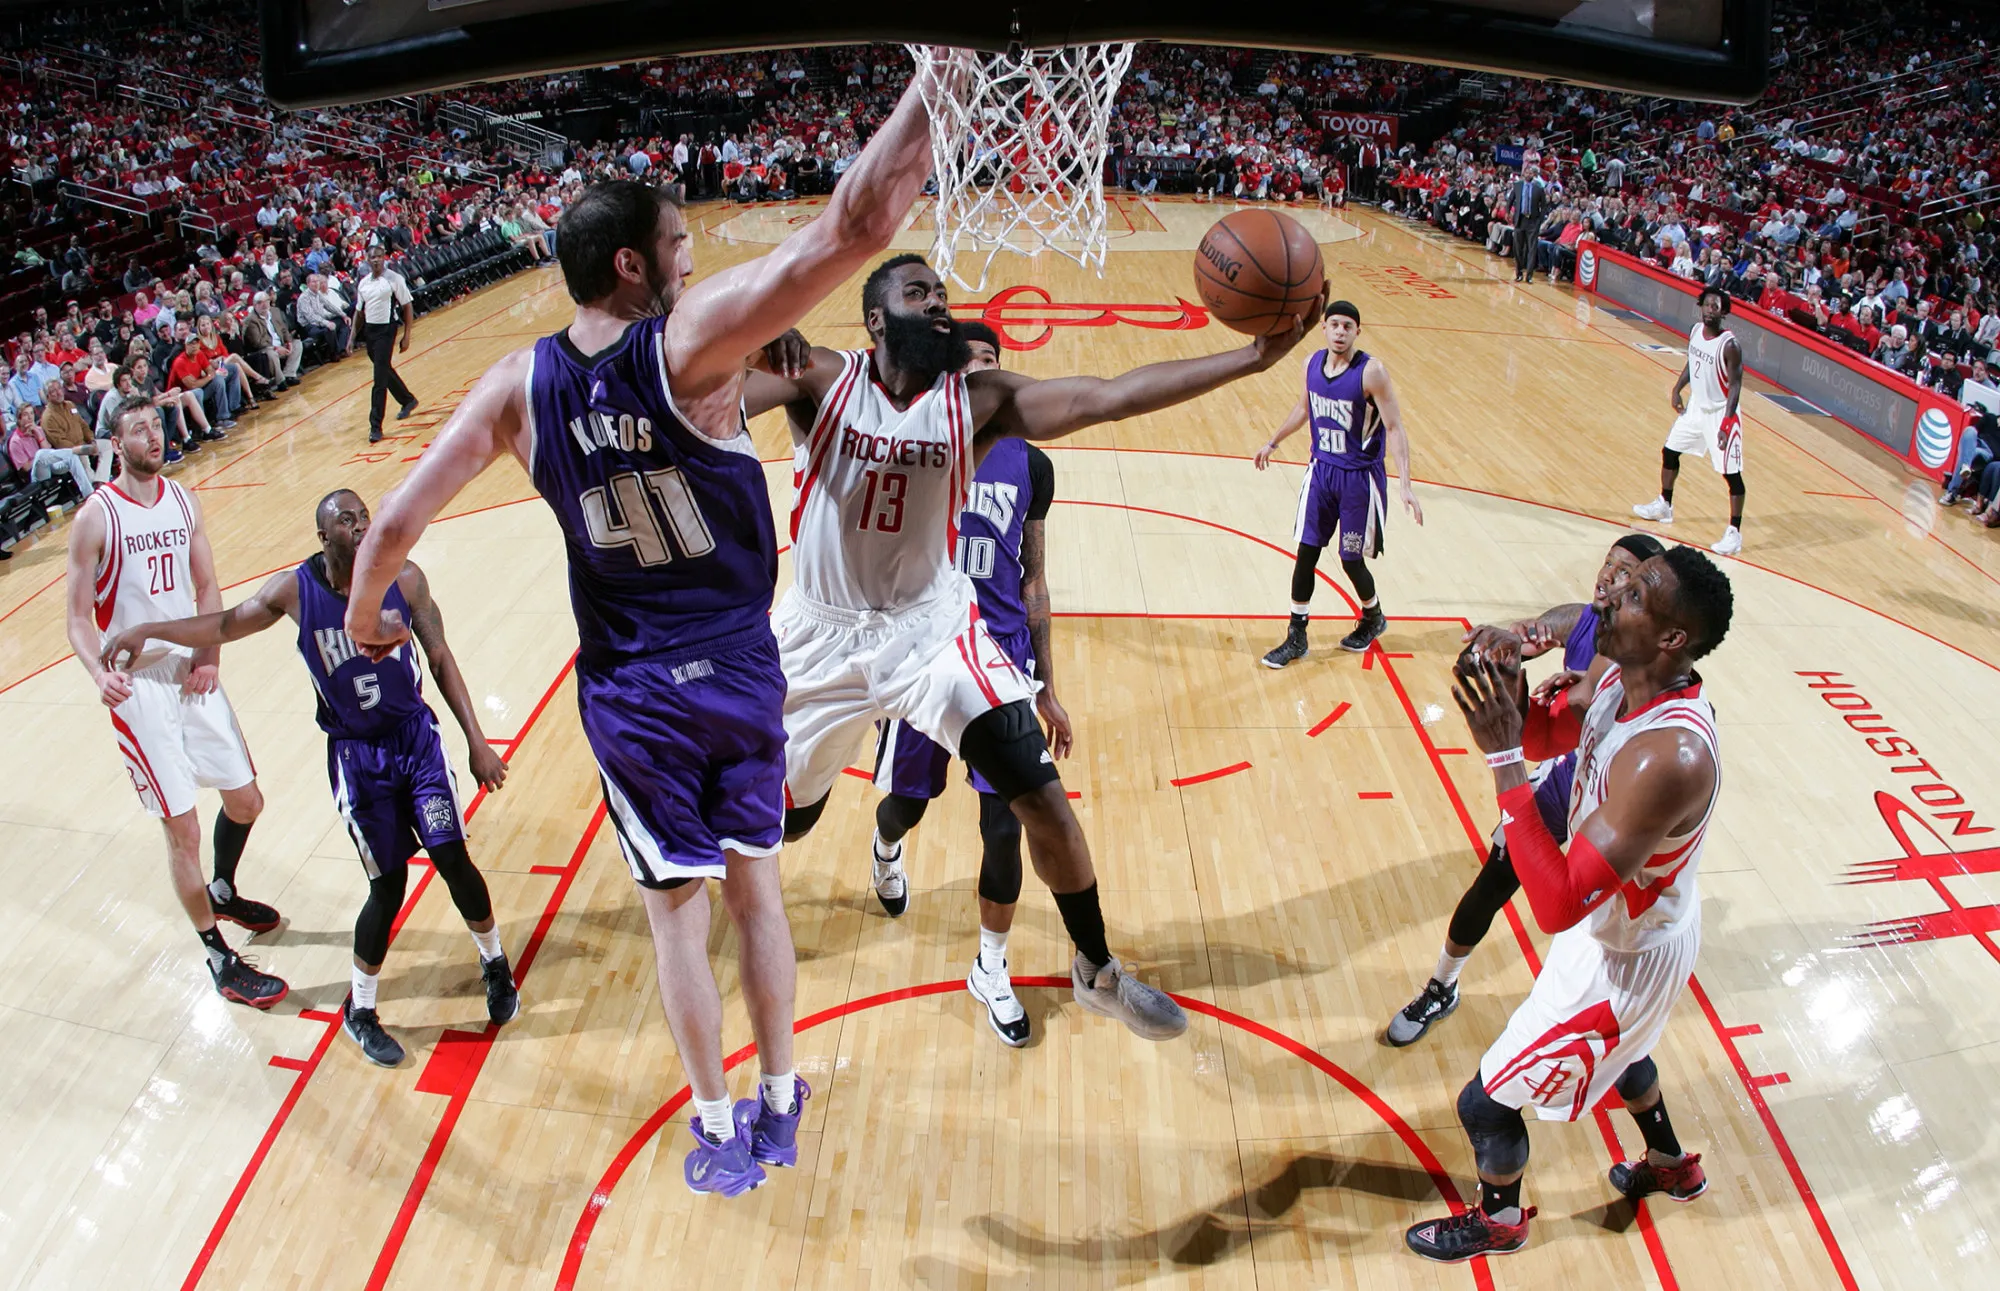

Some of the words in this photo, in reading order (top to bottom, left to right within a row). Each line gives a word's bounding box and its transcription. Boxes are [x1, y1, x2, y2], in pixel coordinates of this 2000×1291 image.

[515, 110, 543, 121] TUNNEL
[1318, 115, 1392, 137] TOYOTA
[1198, 235, 1243, 283] ALDING
[1378, 265, 1458, 299] TOYOTA
[1694, 360, 1701, 380] 2
[1831, 370, 1881, 410] Compass
[1309, 390, 1353, 433] KINGS
[569, 411, 653, 457] KOFOS
[840, 424, 949, 469] ROCKETS
[1318, 426, 1347, 455] 30
[579, 465, 717, 568] 41
[857, 467, 910, 535] 13
[124, 527, 187, 556] ROCKETS
[147, 552, 175, 596] 20
[353, 672, 382, 711] 5
[1793, 671, 1996, 837] HOUSTON
[426, 808, 451, 826] KINGS
